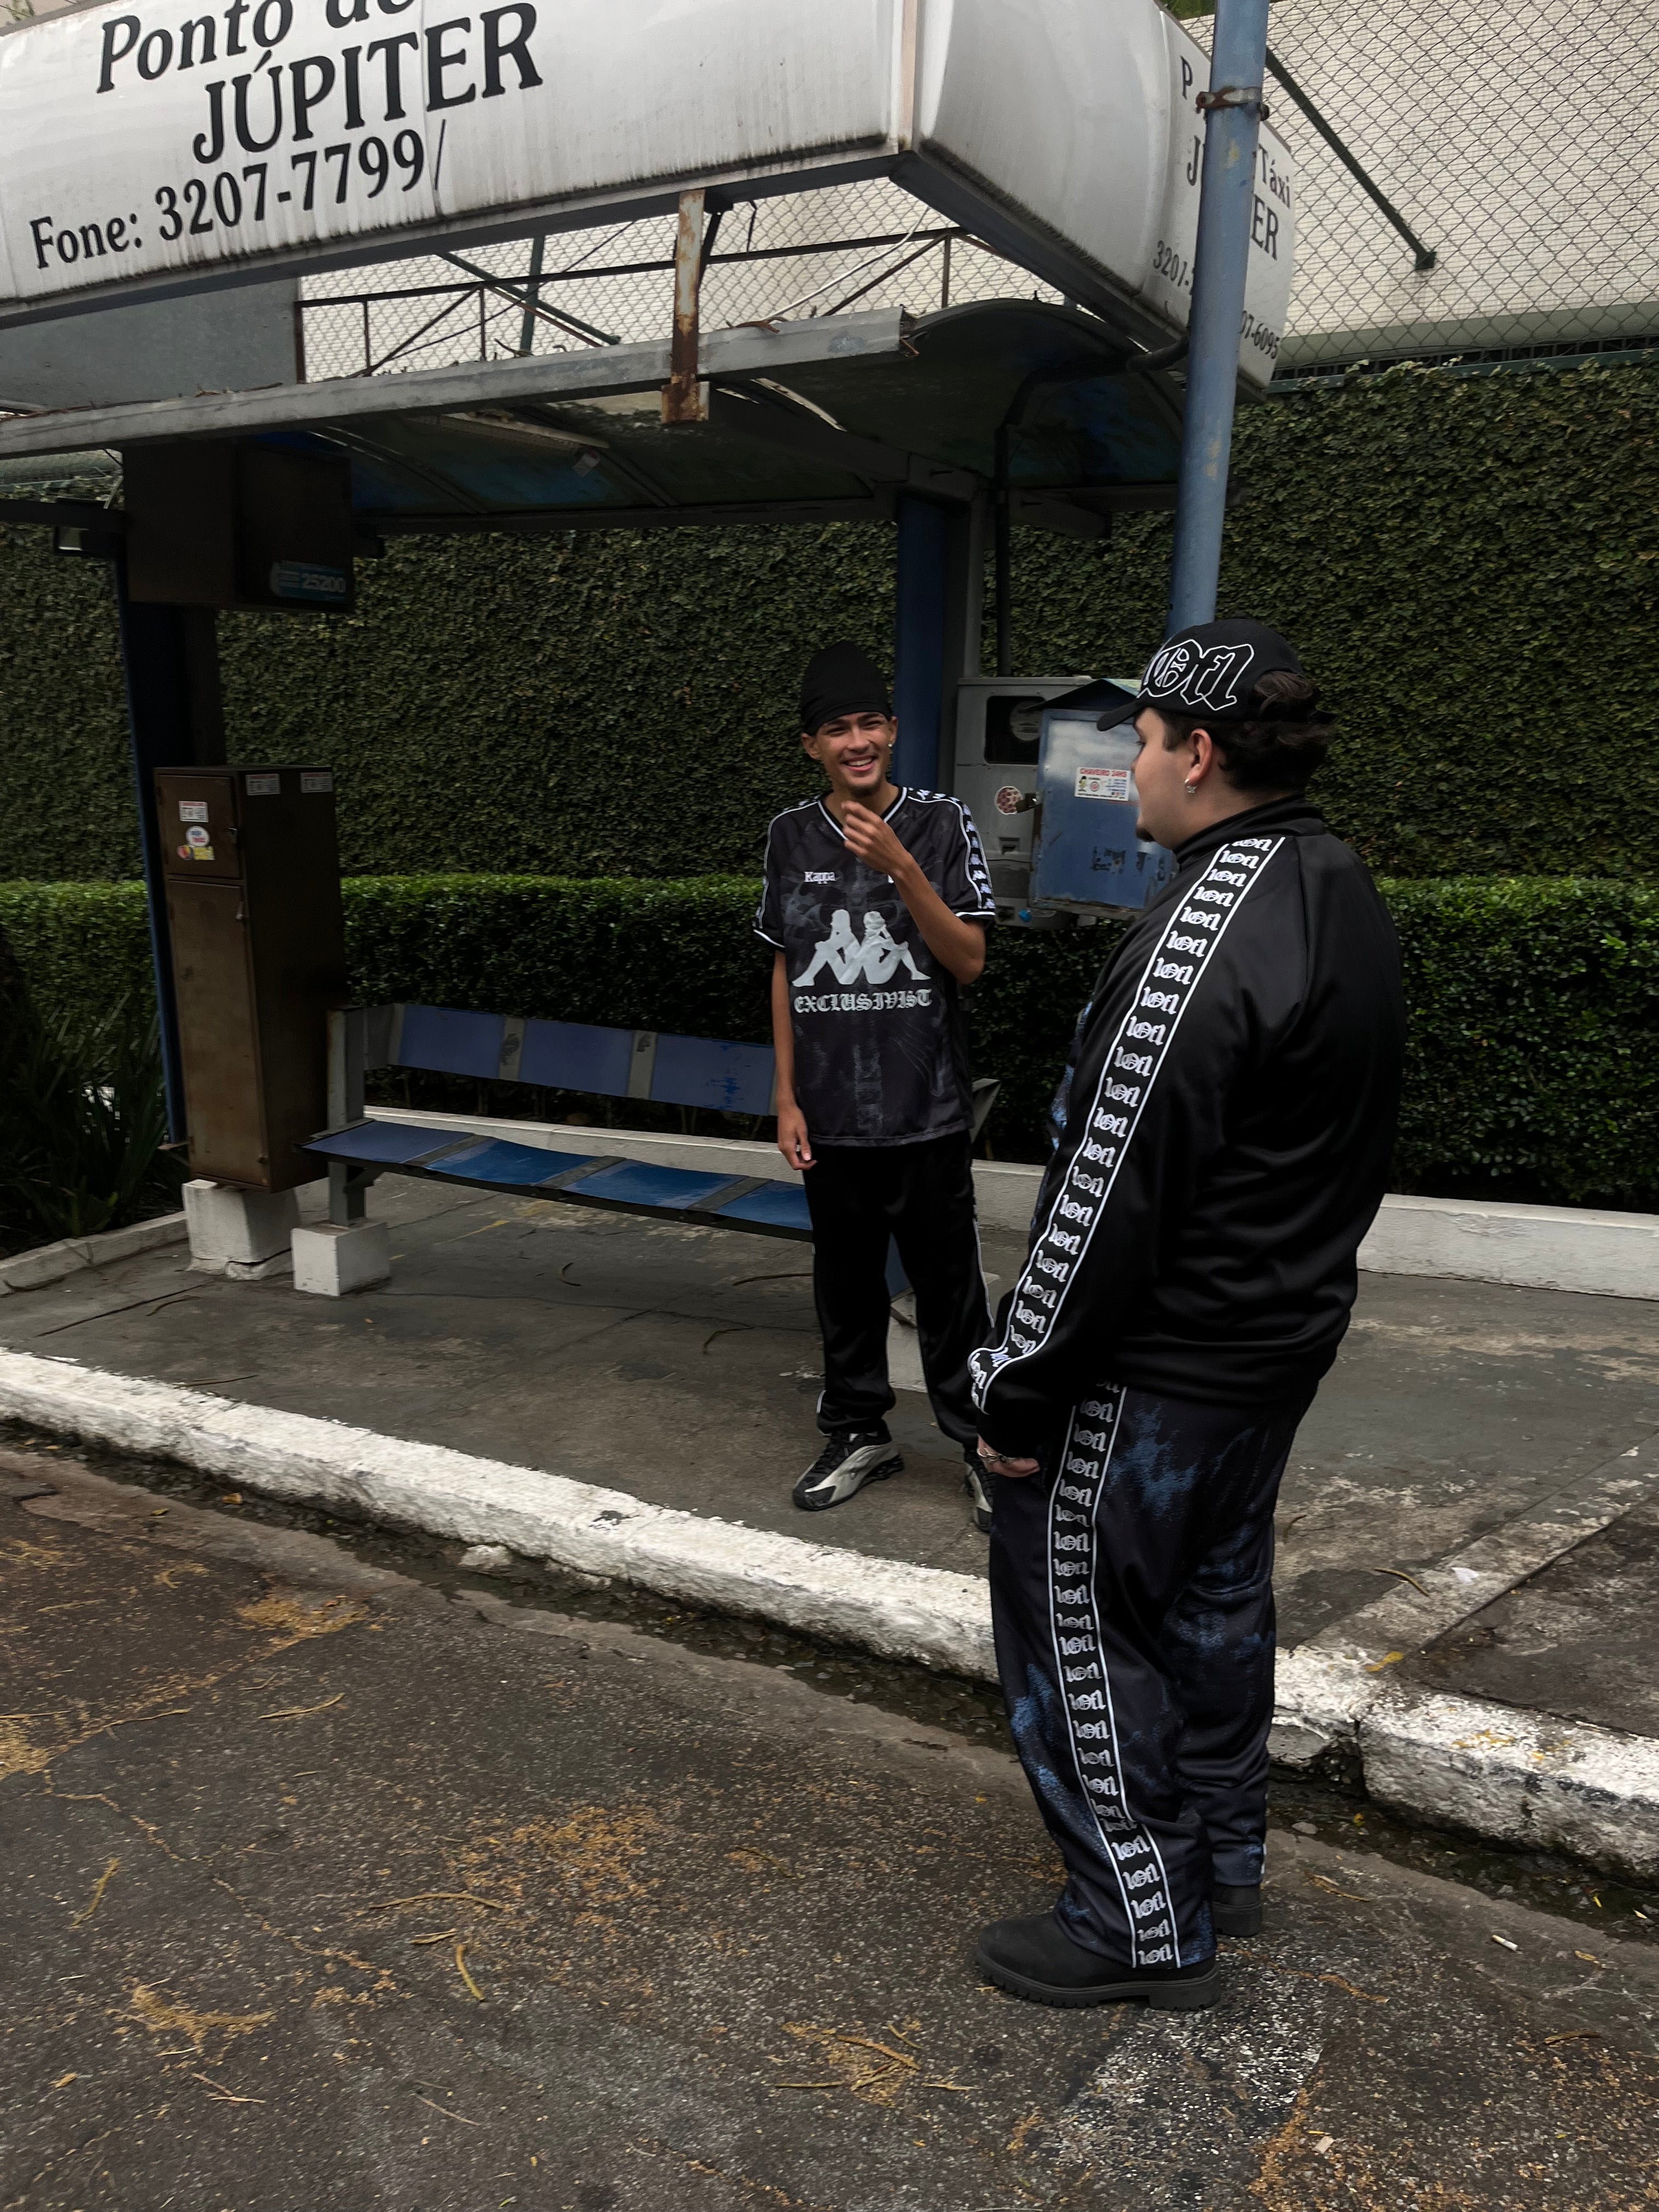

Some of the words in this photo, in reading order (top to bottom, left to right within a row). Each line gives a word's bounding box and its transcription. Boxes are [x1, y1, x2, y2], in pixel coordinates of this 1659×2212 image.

[97, 0, 294, 93] Ponto
[194, 2, 544, 164] JÚPITER
[29, 213, 143, 269] Fone:
[804, 871, 836, 884] Kappa
